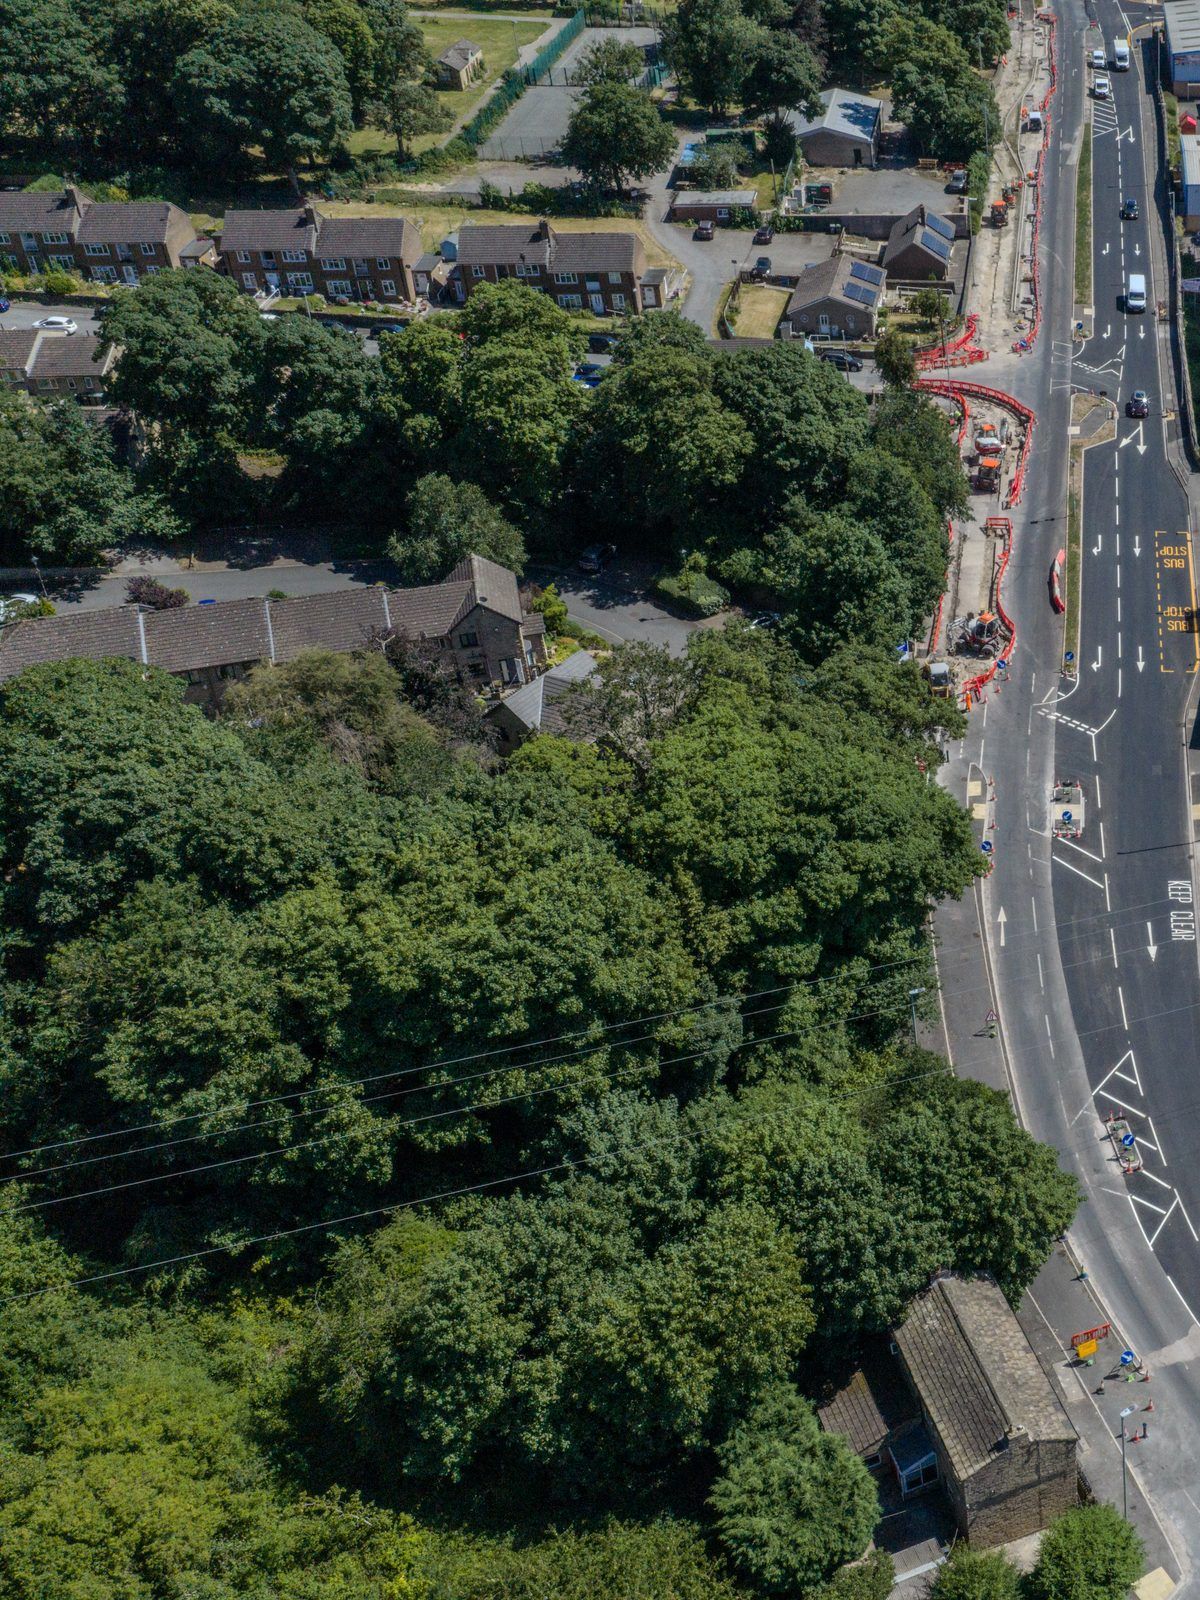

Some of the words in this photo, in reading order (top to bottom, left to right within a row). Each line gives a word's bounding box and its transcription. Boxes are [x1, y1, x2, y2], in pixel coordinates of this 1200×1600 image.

[1160, 546, 1187, 555] STOP
[1164, 559, 1185, 568] BUS
[1163, 606, 1191, 616] STOP
[1168, 620, 1189, 630] BUS
[1168, 880, 1192, 903] KEEP
[1170, 911, 1195, 940] CLEAR
